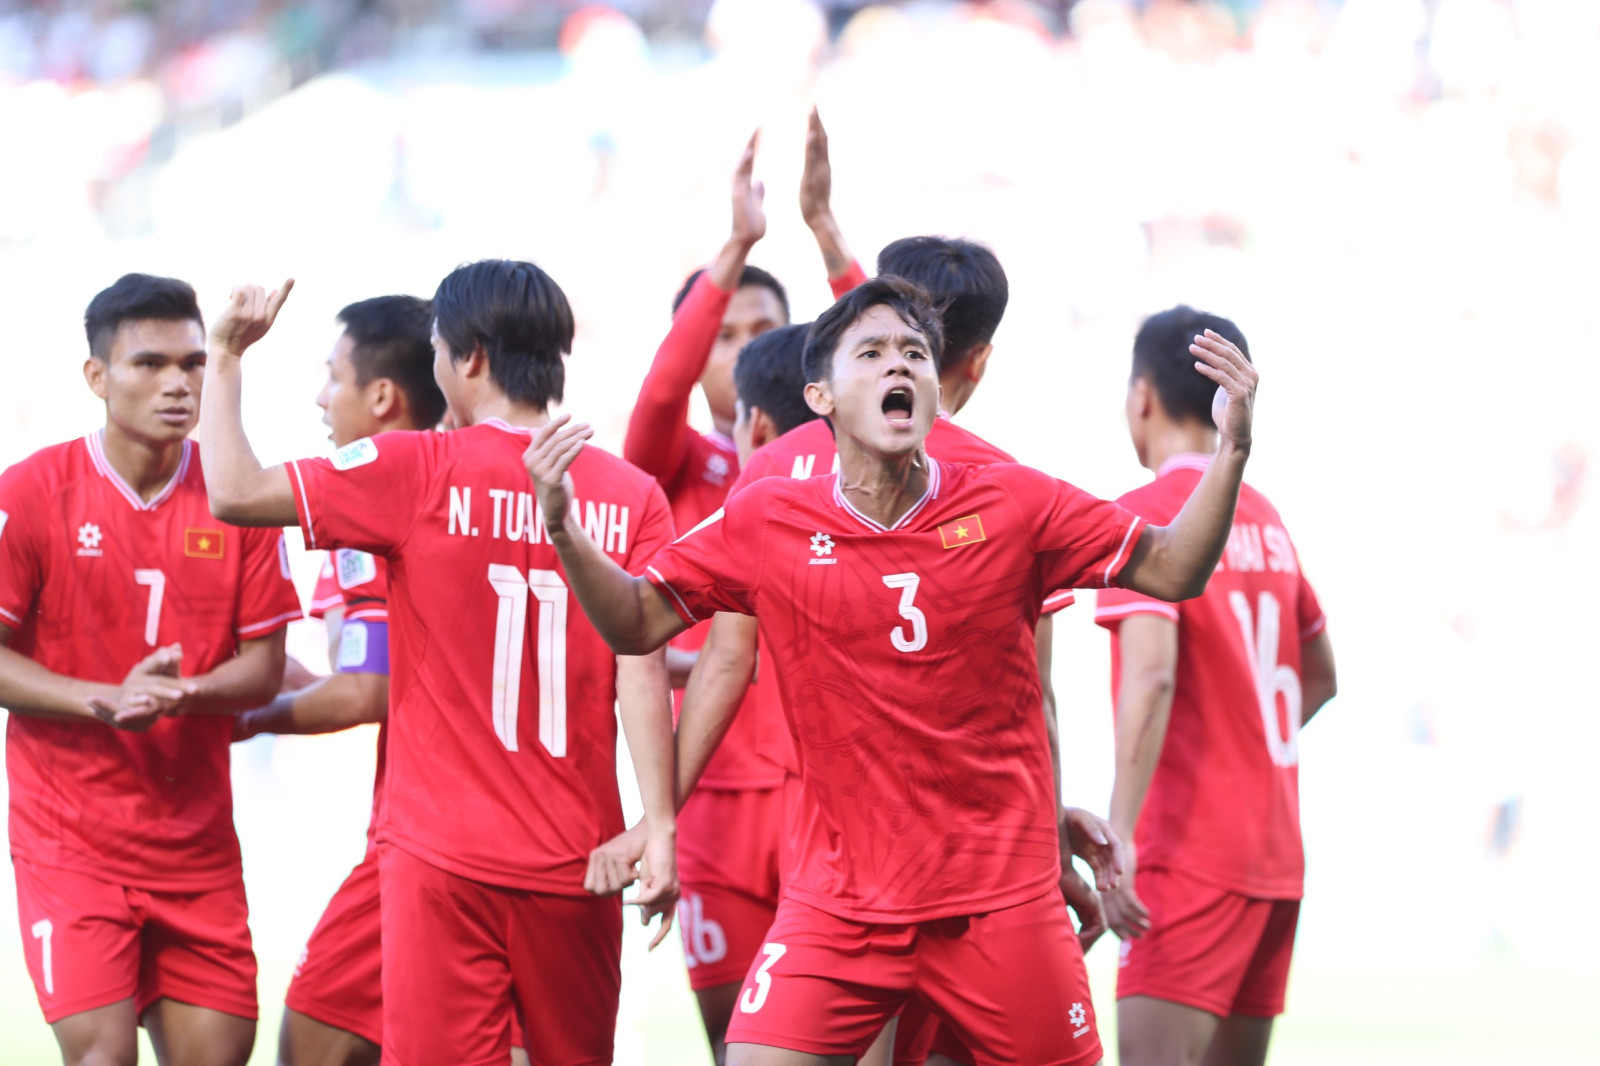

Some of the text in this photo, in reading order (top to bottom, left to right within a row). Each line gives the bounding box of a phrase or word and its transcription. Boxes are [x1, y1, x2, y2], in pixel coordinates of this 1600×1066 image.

[448, 486, 479, 536] N.
[134, 569, 166, 647] 7
[882, 572, 928, 653] 3
[488, 564, 568, 758] 11
[1229, 590, 1302, 769] 16
[740, 942, 787, 1014] 3
